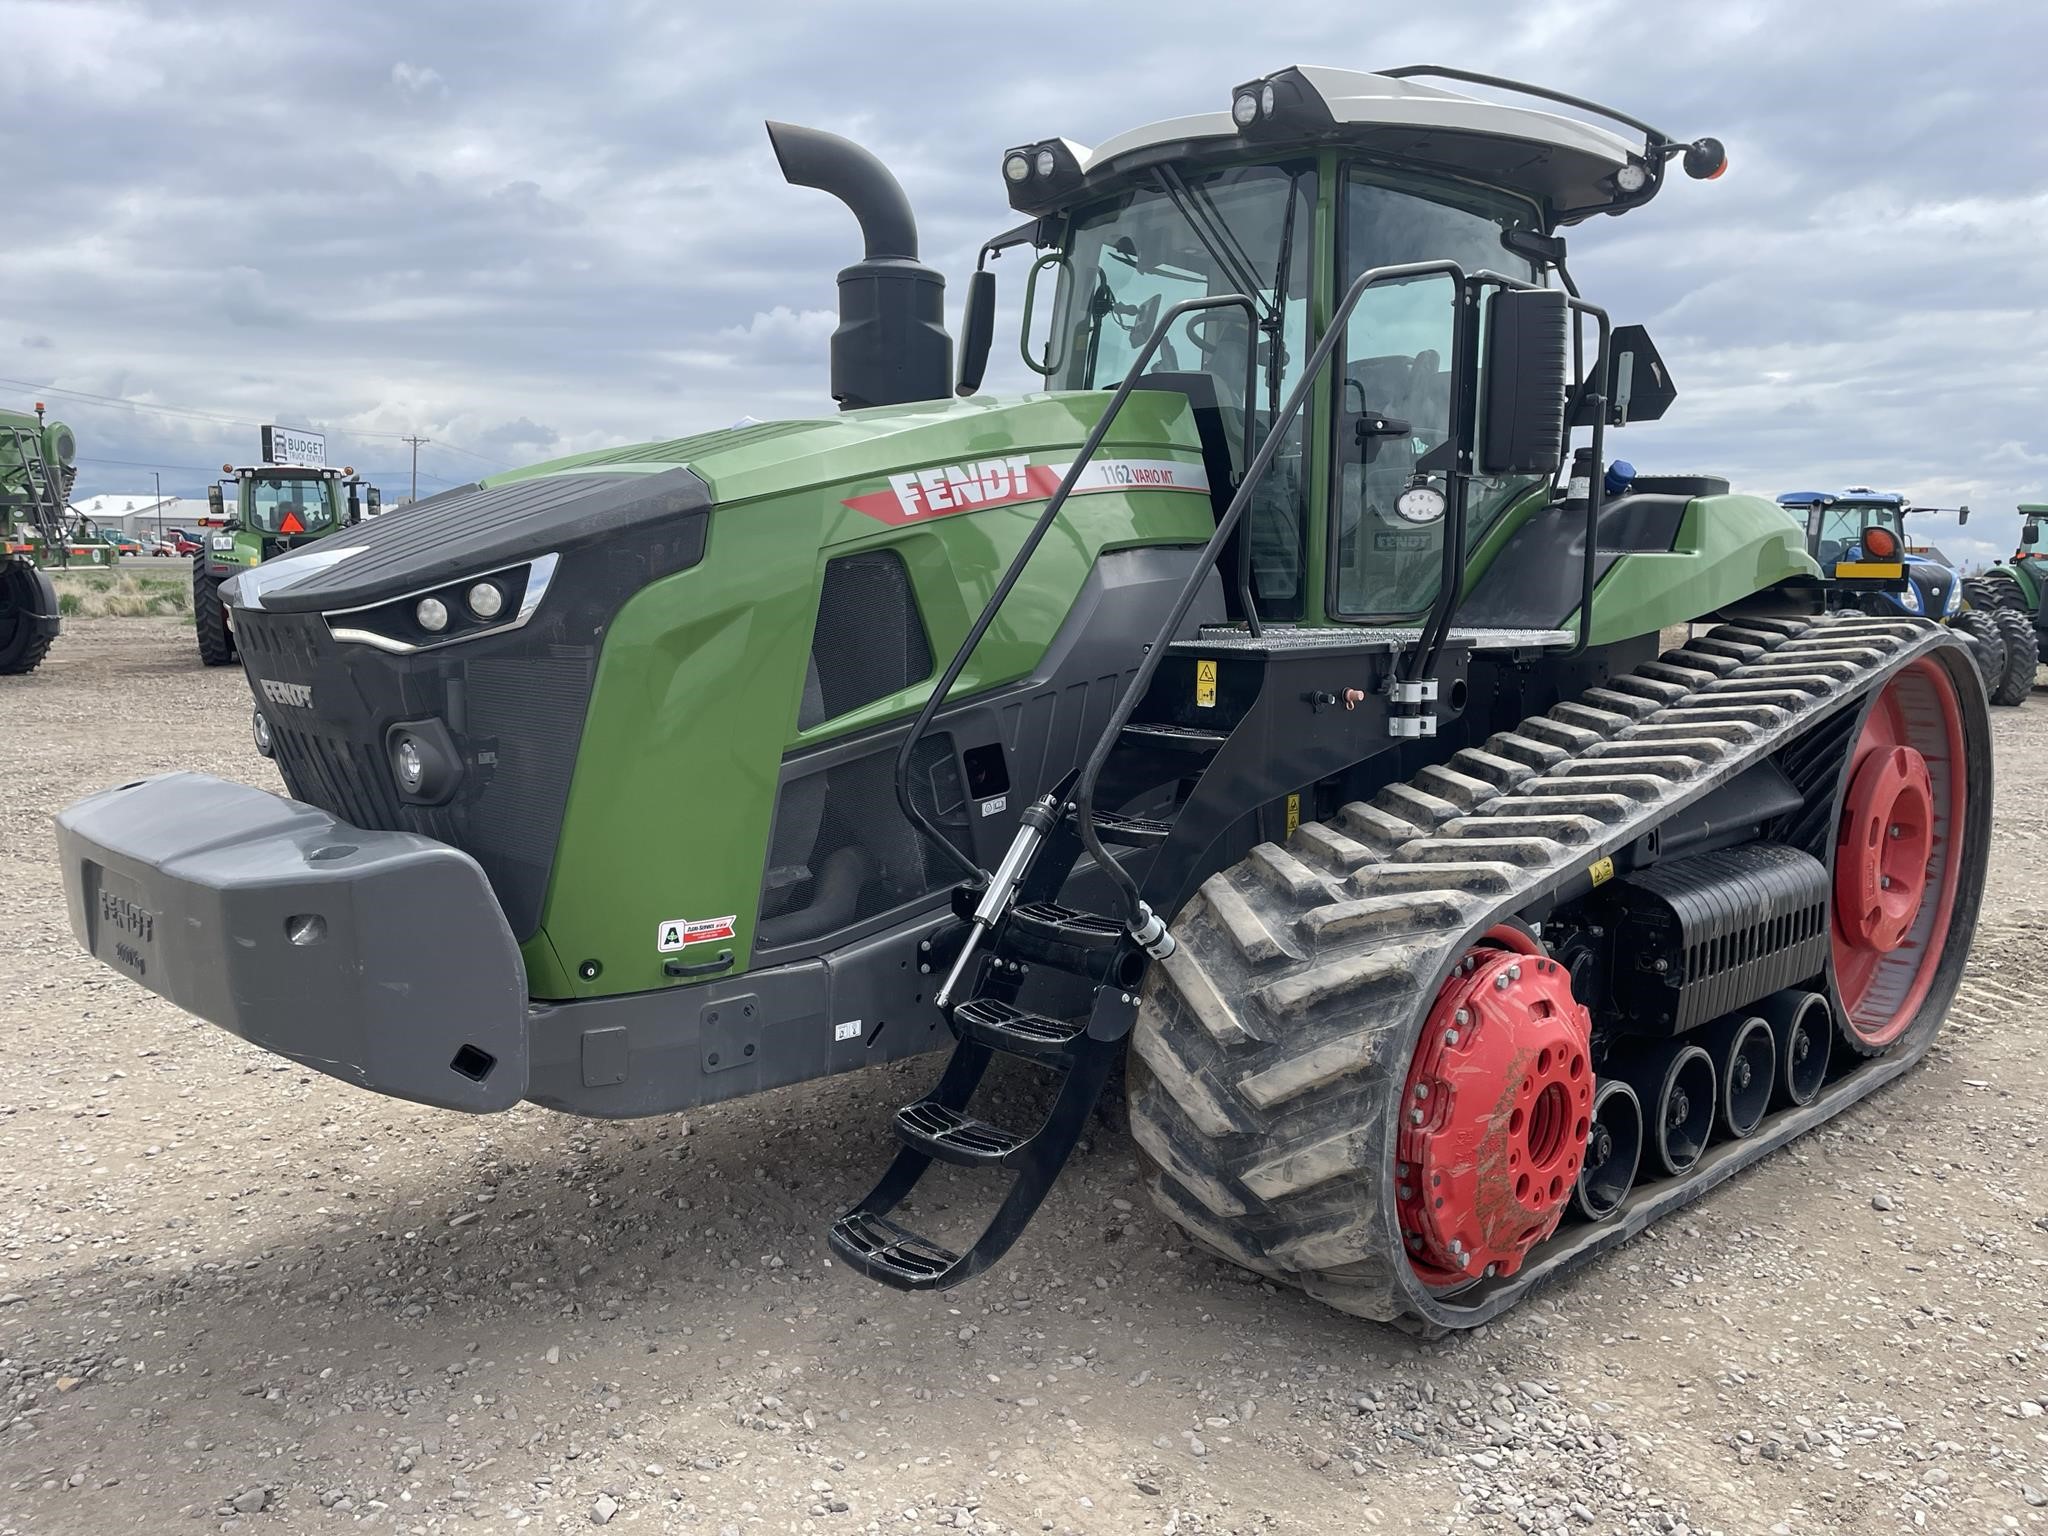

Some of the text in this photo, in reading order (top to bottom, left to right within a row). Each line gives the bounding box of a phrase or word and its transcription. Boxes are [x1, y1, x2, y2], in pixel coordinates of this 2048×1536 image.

[288, 438, 323, 455] BUDGET
[289, 451, 305, 461] TRUCK
[1101, 465, 1174, 484] 1162 VARIO MT
[888, 455, 1030, 515] FENDT
[260, 679, 313, 709] FENDT
